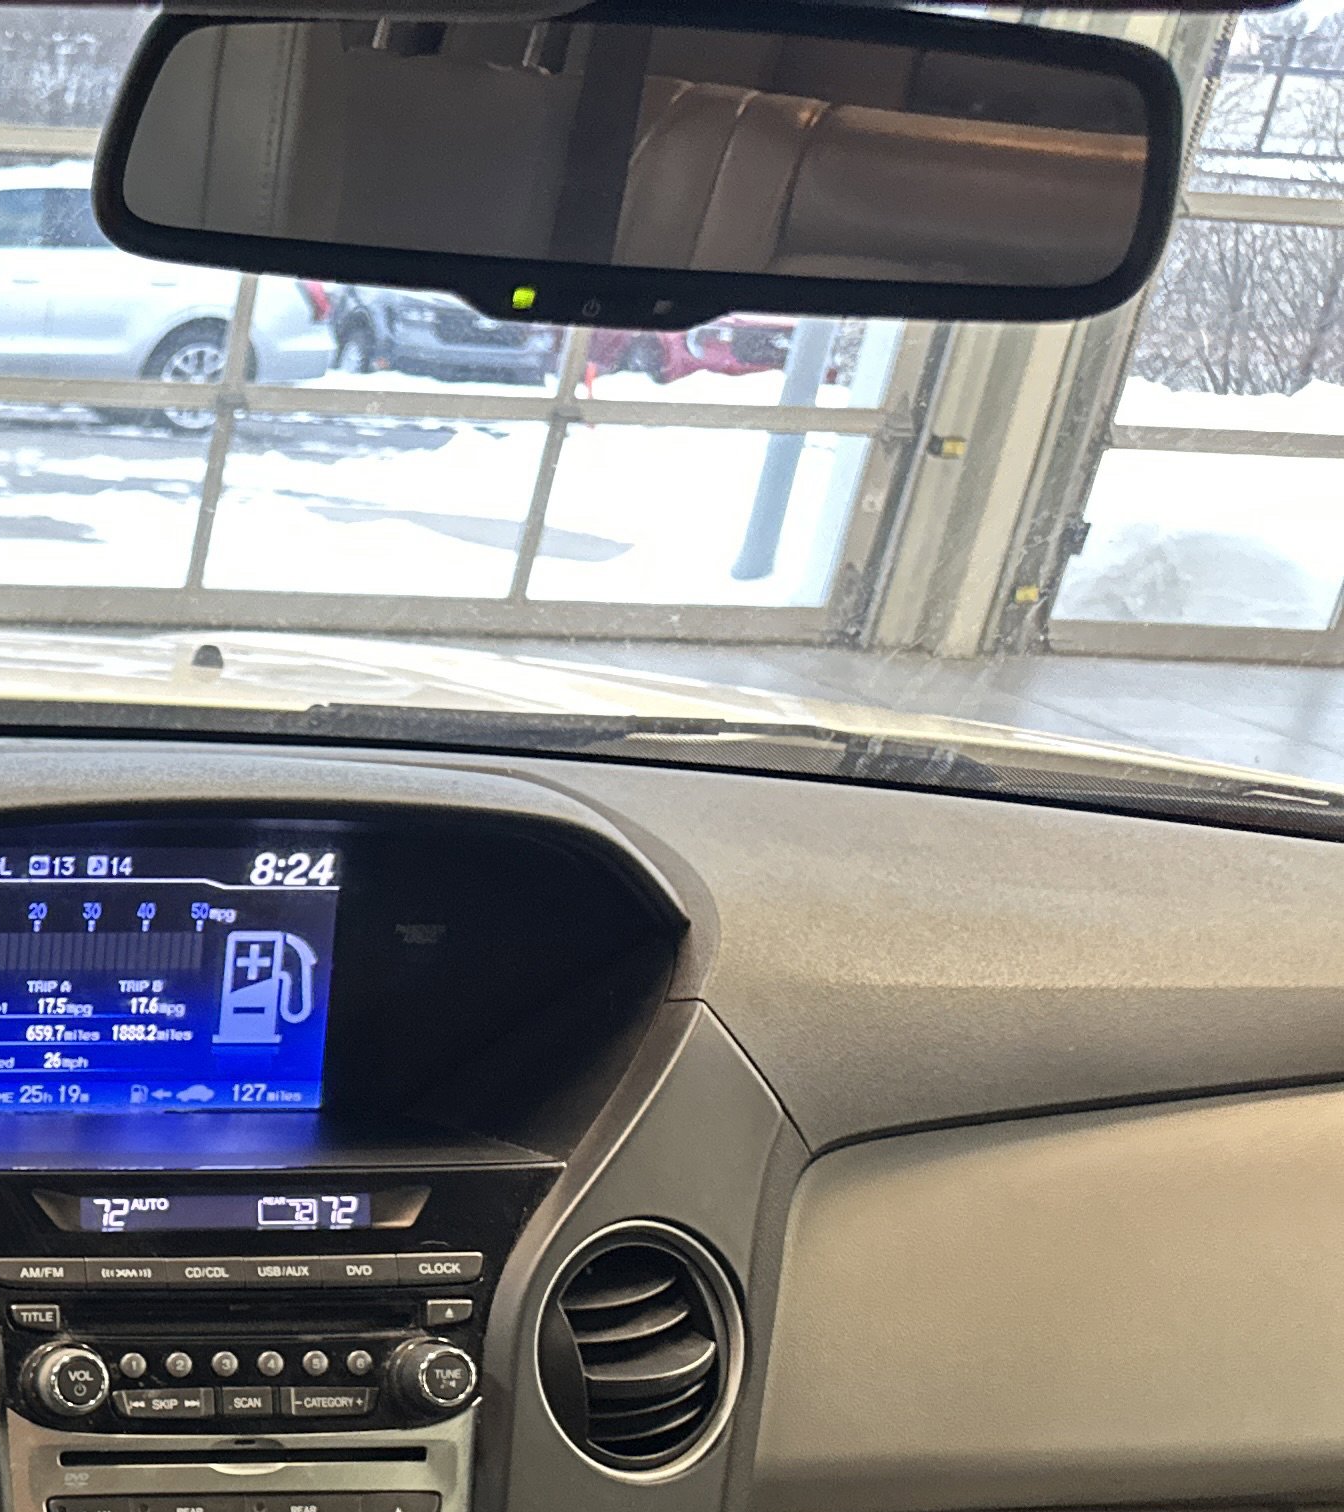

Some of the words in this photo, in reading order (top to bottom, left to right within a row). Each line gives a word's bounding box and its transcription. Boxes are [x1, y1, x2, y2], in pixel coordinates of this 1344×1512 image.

[52, 856, 76, 876] 13
[110, 856, 133, 876] 14
[250, 852, 336, 886] 8:24
[28, 902, 48, 920] 20
[82, 902, 102, 920] 30
[137, 902, 156, 920] 40
[27, 980, 58, 993] TRIP
[60, 980, 72, 993] A
[119, 979, 149, 993] TRIP
[93, 1198, 130, 1227] 72
[130, 1198, 170, 1211] AUTO
[289, 1201, 313, 1221] 72
[321, 1196, 359, 1224] 72
[20, 1267, 64, 1278] AM/FM
[184, 1267, 229, 1278] CD/CDL
[257, 1266, 309, 1277] USB/AUX
[346, 1265, 373, 1276] DVD
[418, 1263, 461, 1275] CLOCK
[20, 1312, 54, 1322] TITLE
[68, 1370, 94, 1382] VOL
[434, 1369, 462, 1379] TUNE
[151, 1399, 179, 1410] SKIP
[233, 1398, 262, 1408] SCAN
[303, 1397, 353, 1408] CATEGORY
